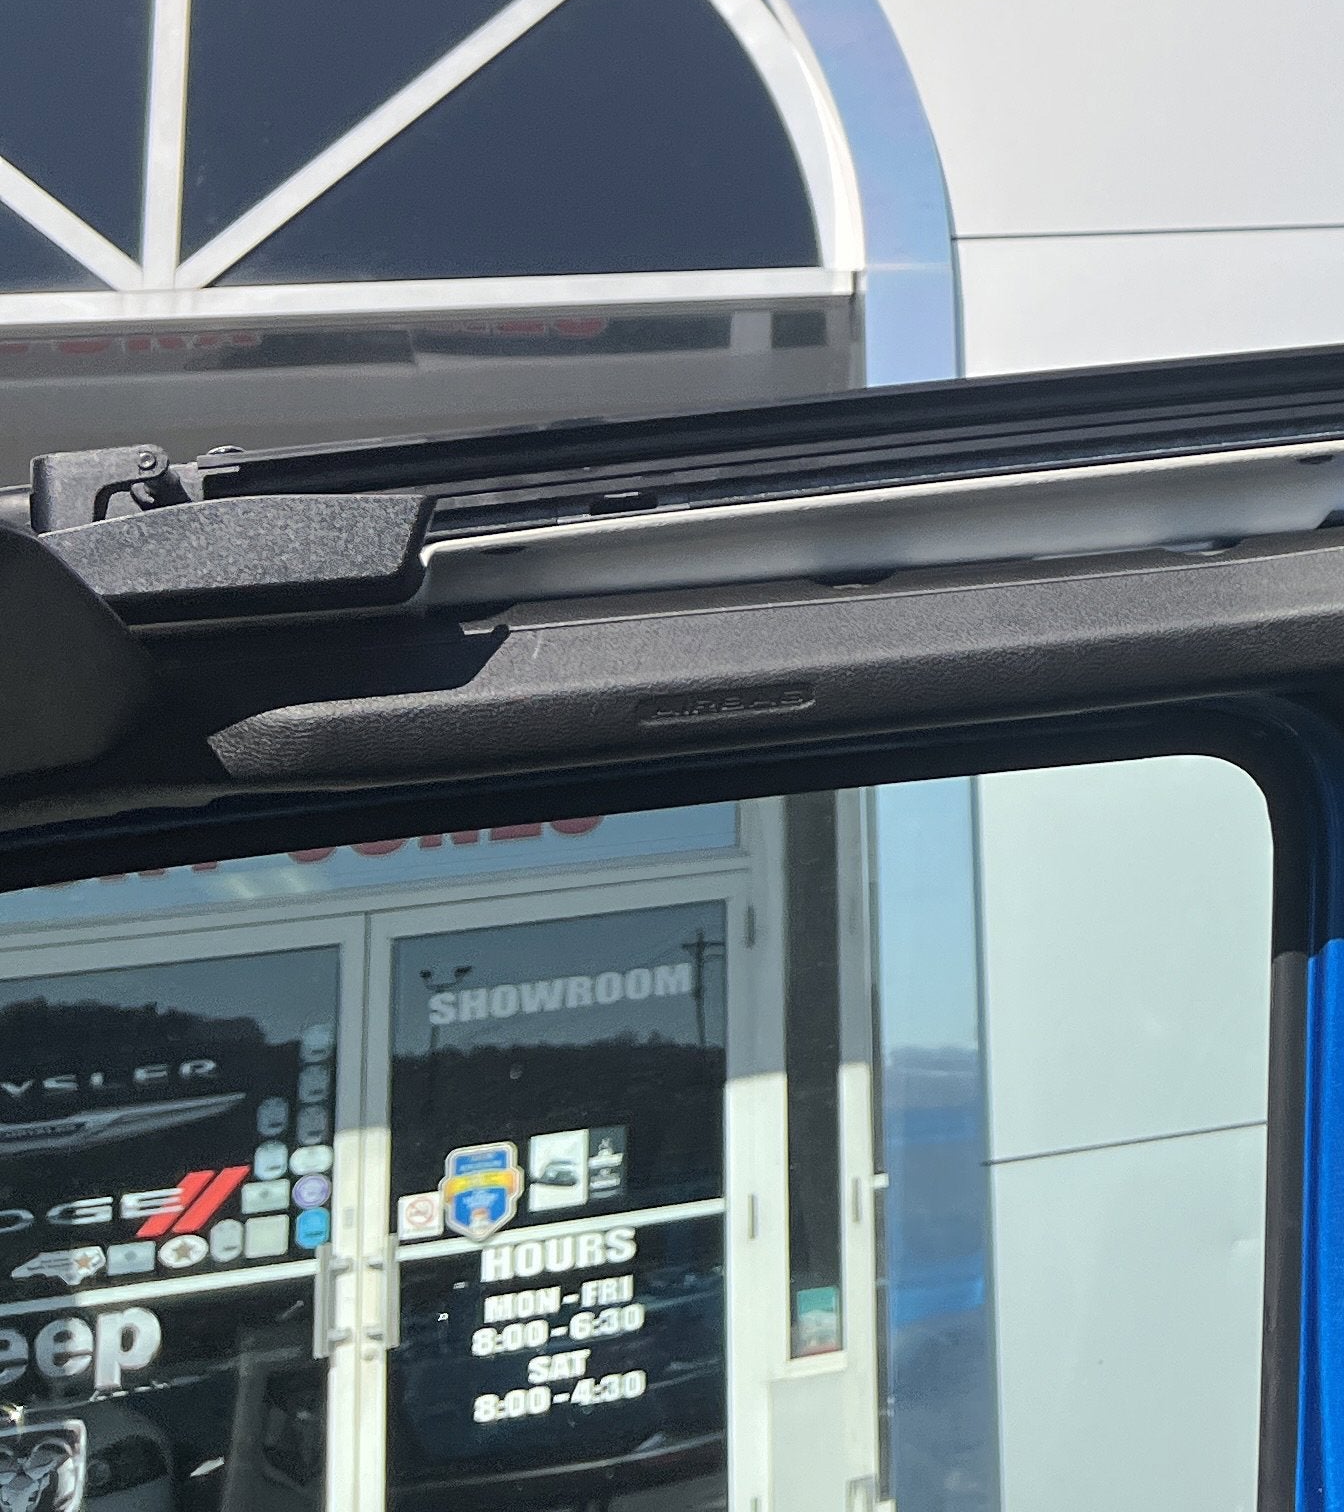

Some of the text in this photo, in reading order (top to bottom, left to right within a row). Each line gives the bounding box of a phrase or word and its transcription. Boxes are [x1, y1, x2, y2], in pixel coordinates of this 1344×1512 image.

[428, 963, 691, 1025] SHOWROOM
[480, 1226, 637, 1282] HOURS
[527, 1348, 591, 1384] SAT
